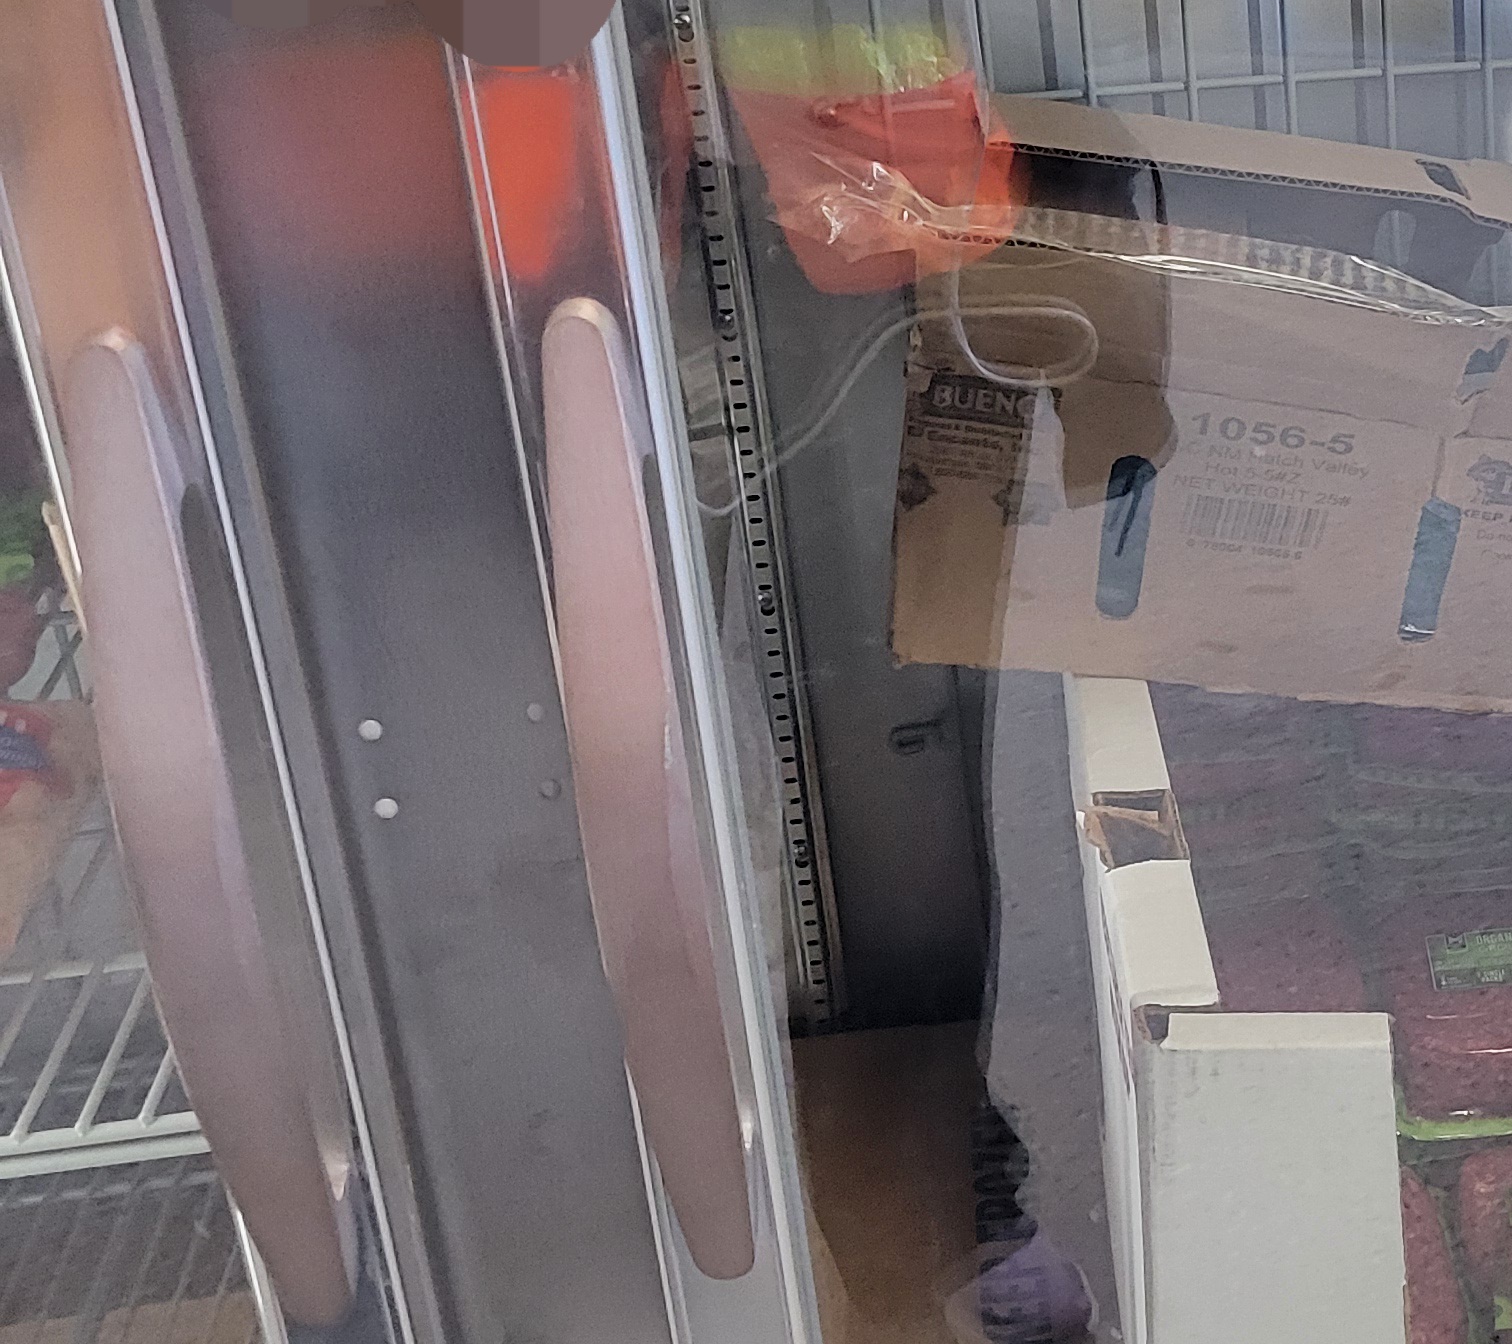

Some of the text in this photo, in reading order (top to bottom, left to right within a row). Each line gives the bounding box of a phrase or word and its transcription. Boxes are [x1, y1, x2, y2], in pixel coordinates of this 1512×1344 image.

[1192, 413, 1355, 454] 1056-5
[1205, 462, 1239, 477] Hot
[1312, 458, 1369, 480] Valley
[1173, 474, 1217, 491] NET
[1222, 482, 1309, 502] WEIGHT
[1461, 509, 1504, 523] KEEP
